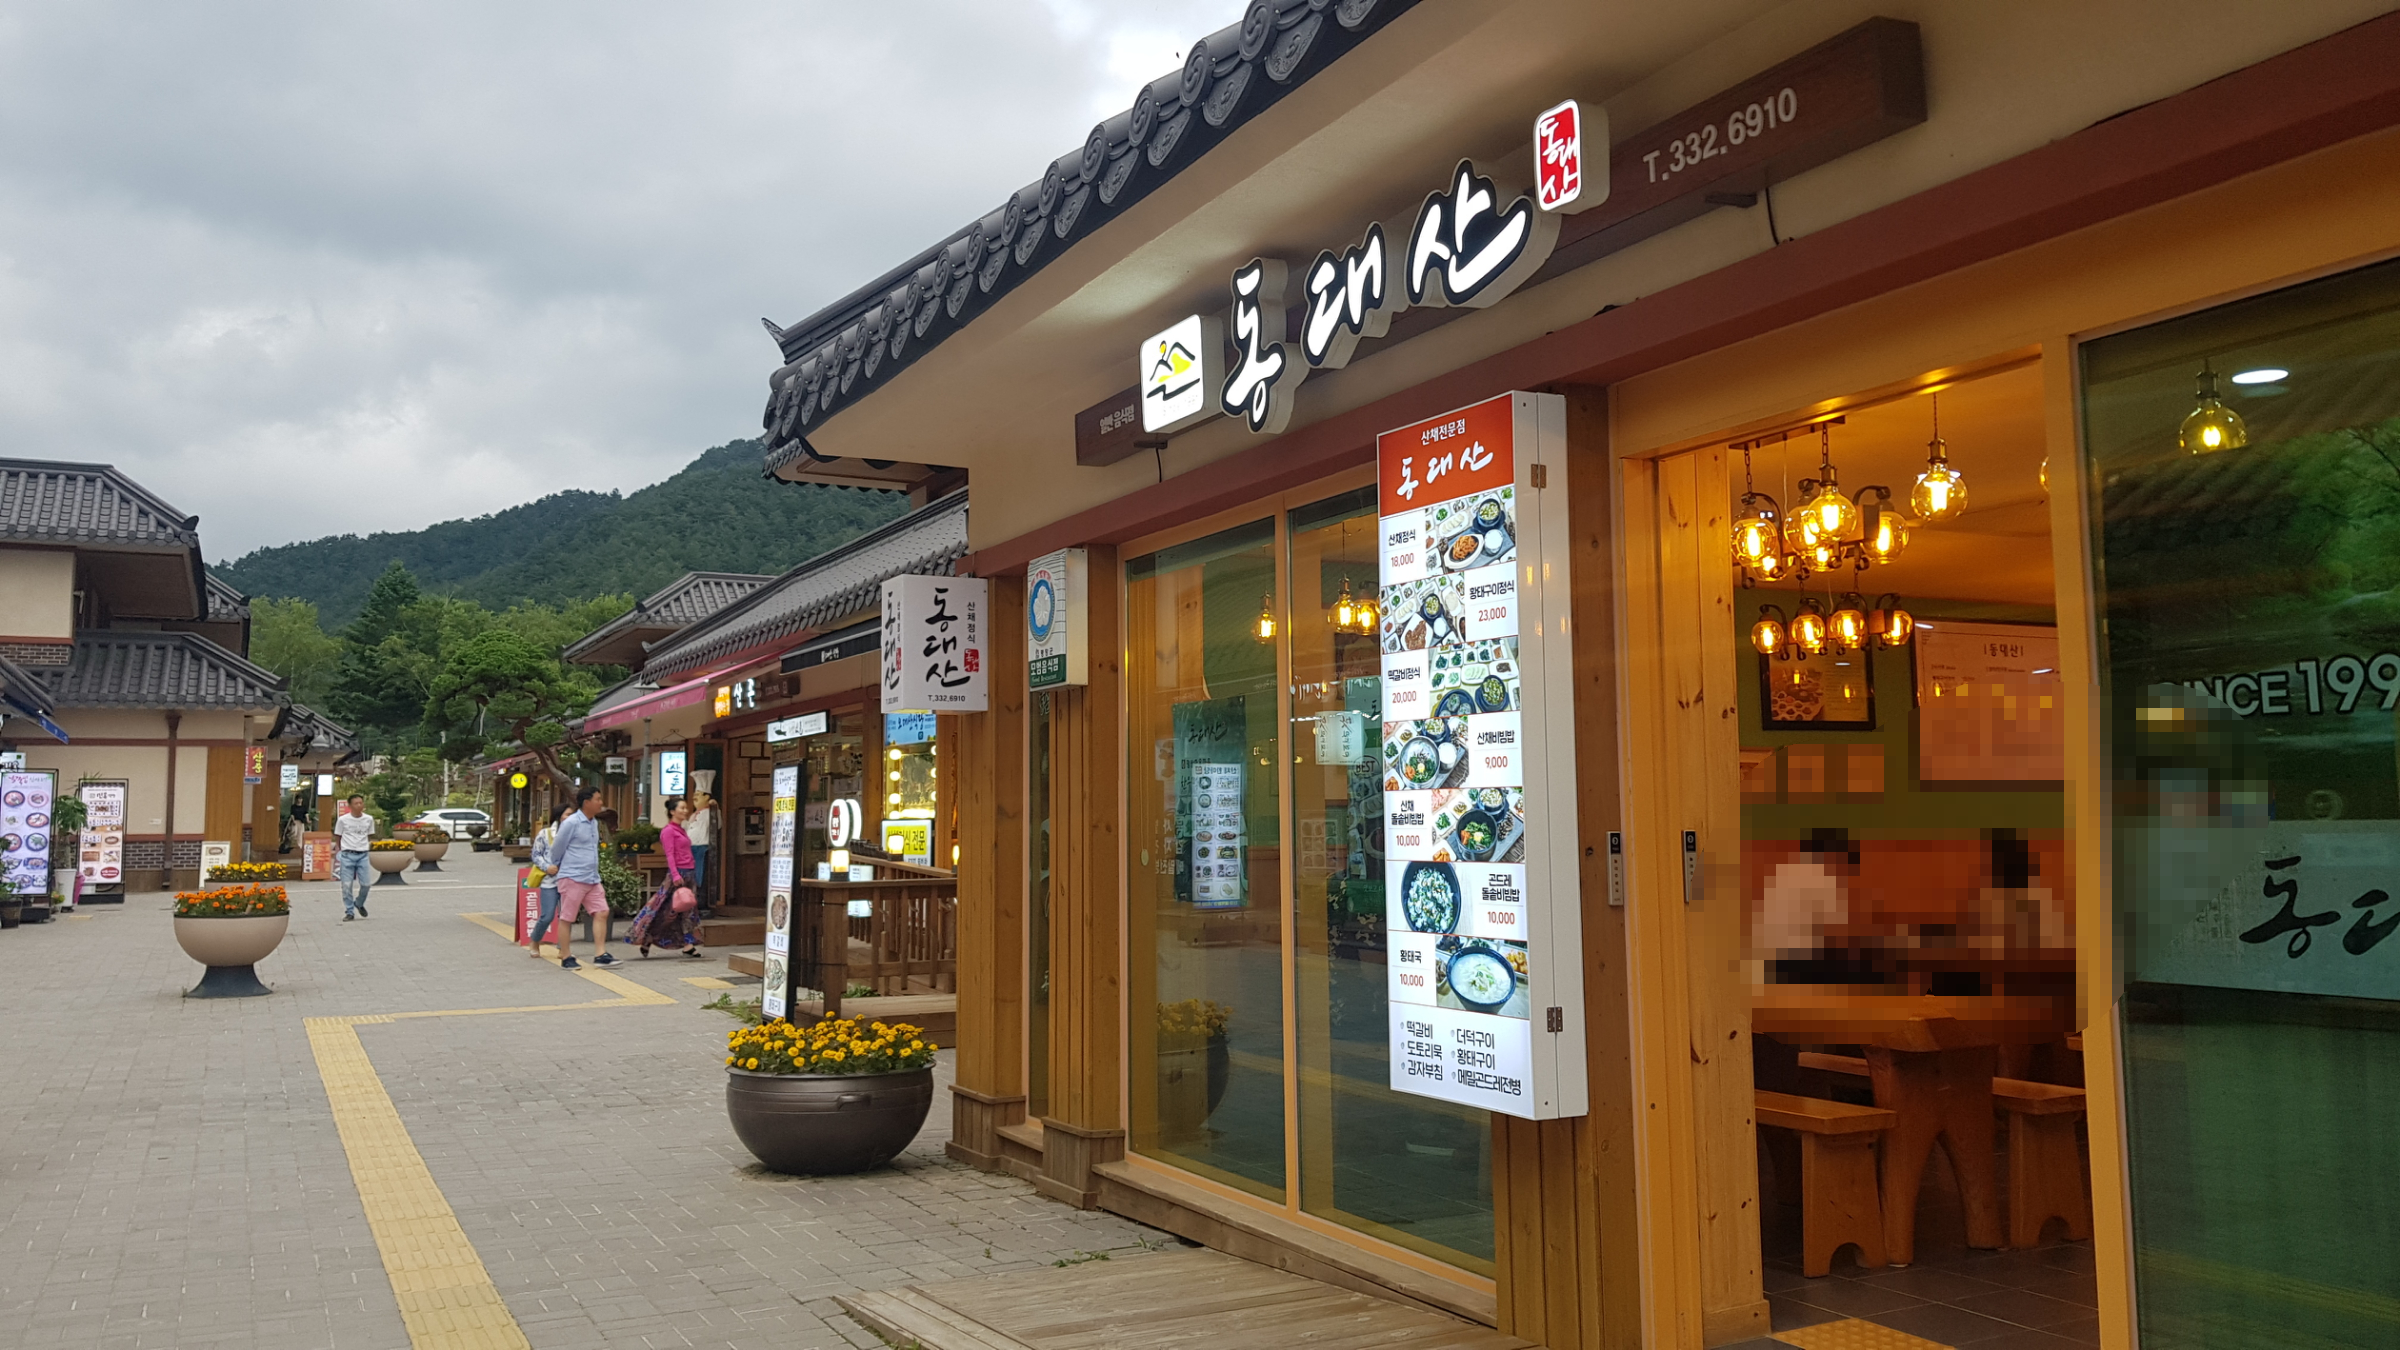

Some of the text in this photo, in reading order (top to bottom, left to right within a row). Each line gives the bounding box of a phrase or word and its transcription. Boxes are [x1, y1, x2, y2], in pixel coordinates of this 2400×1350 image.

[1642, 87, 1798, 183] T.332.6910
[1420, 418, 1466, 446] 산채전문점
[1388, 529, 1416, 546] 산채정식
[1391, 553, 1414, 568] 18,000
[1469, 580, 1515, 600] 황태구이정식
[1478, 606, 1507, 622] 23,000
[967, 602, 976, 643] 산채정식
[1989, 643, 2018, 657] 동대산
[1031, 658, 1058, 676] 모범음식점
[1388, 666, 1421, 682] 떡갈비정식
[1392, 691, 1417, 704] 20,000
[1485, 755, 1508, 769] 9,000
[1400, 799, 1415, 812] 산채
[1396, 835, 1420, 847] 10,000
[1488, 873, 1512, 888] 곤드레
[1487, 911, 1515, 925] 10,000
[1400, 949, 1422, 963] 황태국
[1400, 973, 1424, 987] 10,000
[1406, 1020, 1433, 1039] 떡갈비
[1456, 1028, 1495, 1049] 더덕구이
[1407, 1040, 1442, 1060] 도토리묵
[1457, 1048, 1495, 1070] 황태구이
[1407, 1059, 1443, 1081] 감자부침
[1457, 1069, 1522, 1096] 메밀곤드레전병
